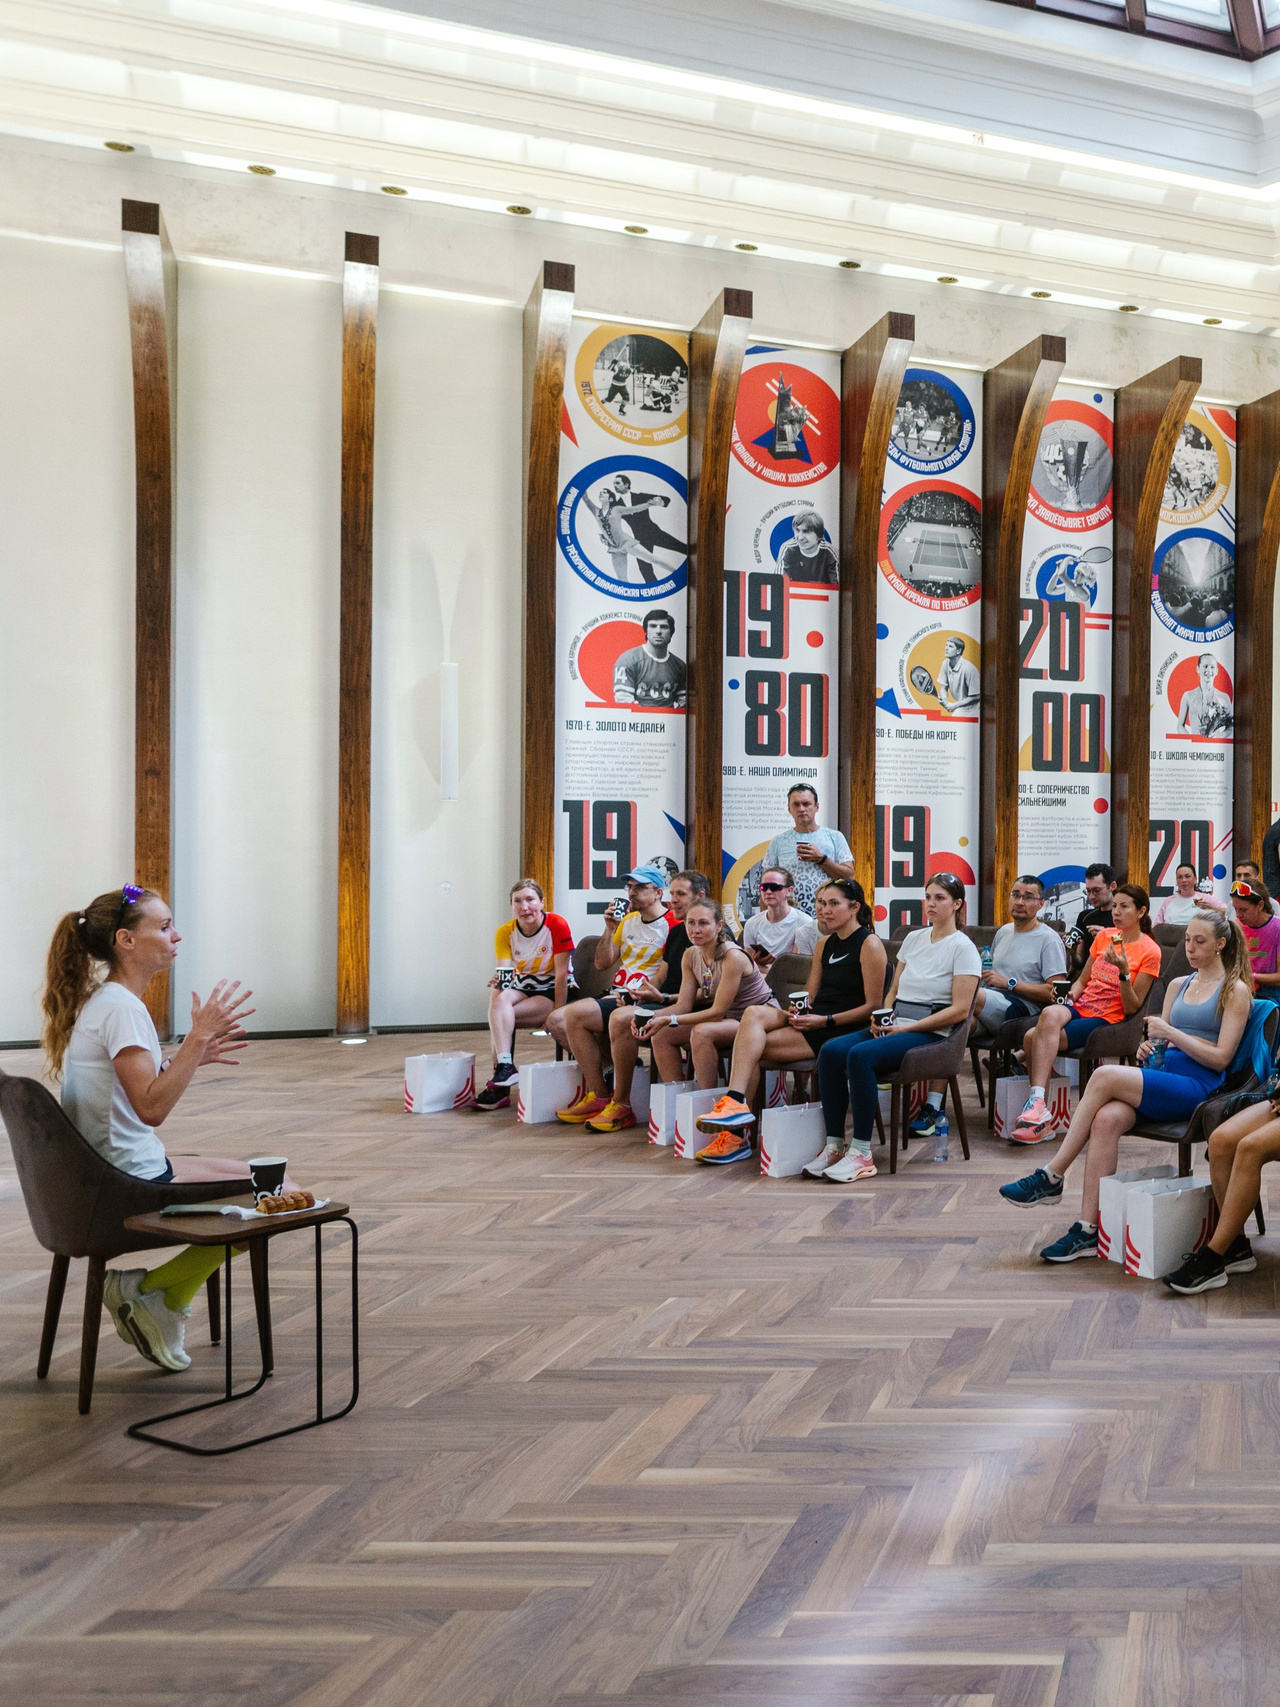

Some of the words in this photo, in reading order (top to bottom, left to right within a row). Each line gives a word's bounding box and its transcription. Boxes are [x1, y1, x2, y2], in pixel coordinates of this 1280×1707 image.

[581, 381, 593, 396] 1972
[585, 396, 623, 434] СУПЕРСЕРИЯ
[622, 427, 642, 440] СССР
[652, 425, 681, 441] КАНАДА
[733, 442, 758, 469] КАНАДЫ
[761, 467, 787, 482] НАШИХ
[788, 461, 828, 483] ХОККЕИСТОВ
[899, 454, 945, 472] ФУТБОЛЬНОГО
[943, 450, 963, 468] КЛУБА
[773, 500, 797, 512] ФУТБОЛИСТ
[797, 499, 815, 508] СТРАНЫ
[1035, 504, 1085, 528] ЗАВОЁВЫВАЕТ
[1086, 504, 1112, 527] ЕВРОПУ
[566, 544, 596, 582] ТРЁХКРАТНАЯ
[594, 575, 640, 597] ОЛИМПИЙСКАЯ
[641, 580, 677, 598] ЧЕМПИОНКА
[888, 573, 908, 593] КУБОК
[905, 589, 931, 608] КРЕМЛЯ
[931, 599, 941, 609] ПО
[941, 596, 969, 610] ТЕННИСУ
[600, 611, 623, 621] ХОККЕИСТ
[624, 612, 643, 622] СТРАНЫ
[1151, 590, 1178, 630] ЧЕМПИОНАТ
[1175, 625, 1195, 641] МИРА
[1195, 631, 1205, 642] ПО
[1206, 620, 1234, 642] ФУТБОЛУ
[1019, 598, 1085, 682] 20
[614, 666, 628, 684] 14
[745, 669, 830, 758] 80
[566, 720, 593, 730] 1970-Е.
[596, 721, 627, 732] ЗОЛОТО
[629, 722, 665, 733] МЕДАЛЕЙ
[896, 729, 923, 740] ПОБЕДЫ
[925, 730, 934, 739] НА
[936, 731, 957, 740] КОРТЕ
[1032, 690, 1106, 773] 00
[1166, 752, 1187, 760] ШКОЛА
[1189, 752, 1224, 761] ЧЕМПИОНОВ
[723, 766, 746, 776] 980-Е.
[748, 767, 770, 776] НАША
[773, 767, 817, 778] ОЛИМПИАДА
[1037, 785, 1089, 794] СОПЕРНИЧЕСТВО
[1018, 797, 1066, 807] СИЛЬНЕЙШИМИ
[563, 799, 638, 891] 19
[875, 804, 931, 888] 19
[498, 971, 512, 981] fix
